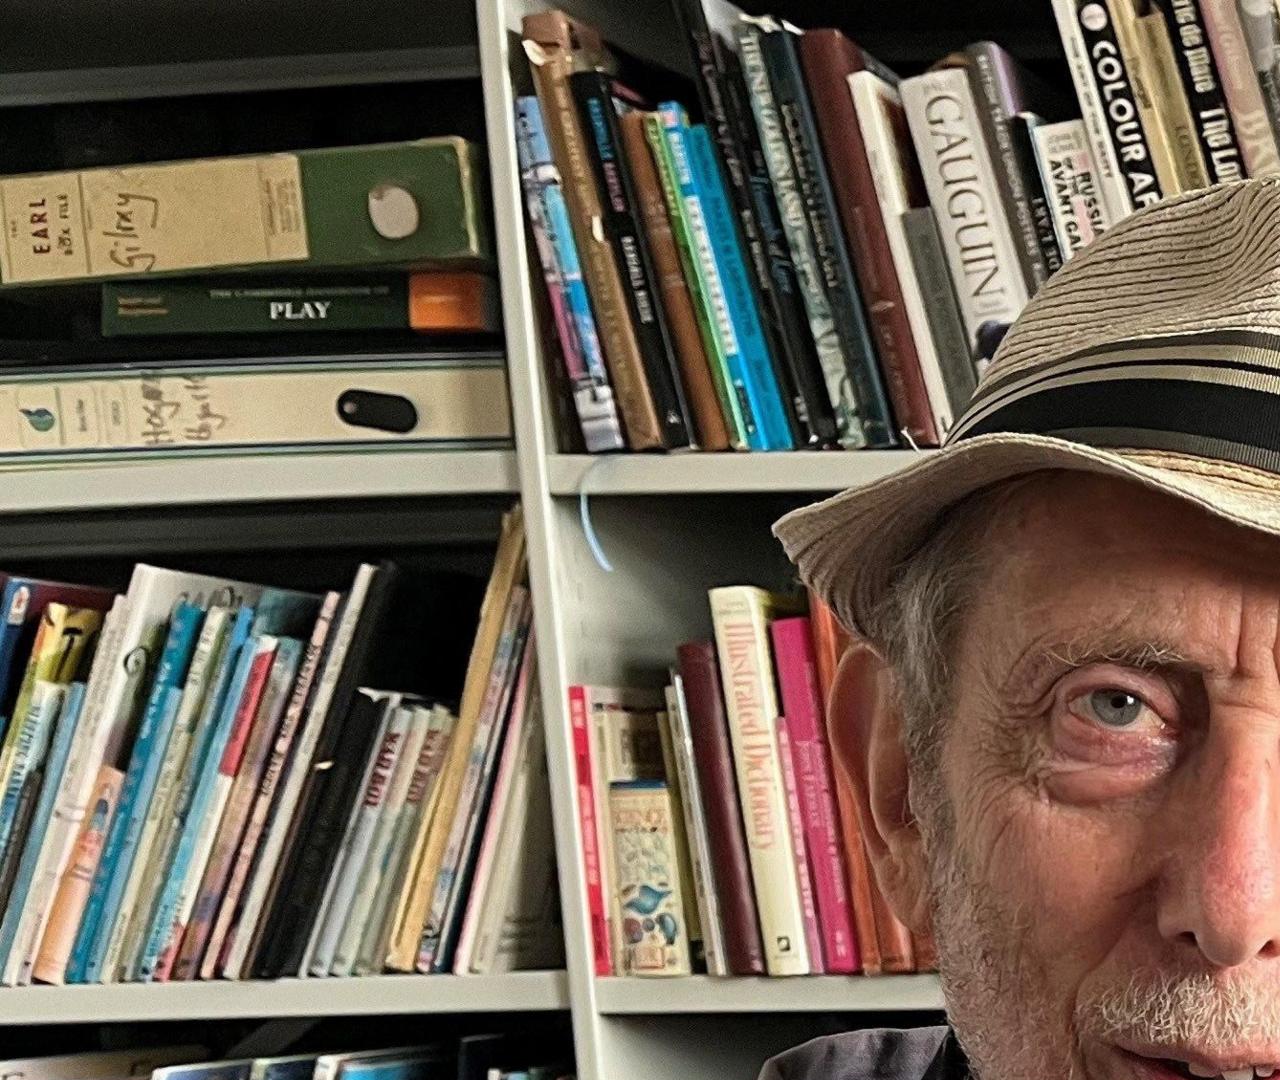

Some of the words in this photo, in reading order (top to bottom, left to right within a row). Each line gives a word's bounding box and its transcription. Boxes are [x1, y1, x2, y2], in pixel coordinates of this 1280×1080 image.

[1092, 40, 1147, 162] COLOUR
[1200, 107, 1233, 148] The
[28, 197, 51, 255] EARL
[925, 94, 1005, 297] GAUGUIN
[269, 301, 331, 320] PLAY
[723, 620, 762, 737] Illustrated
[735, 742, 780, 850] Dictionary
